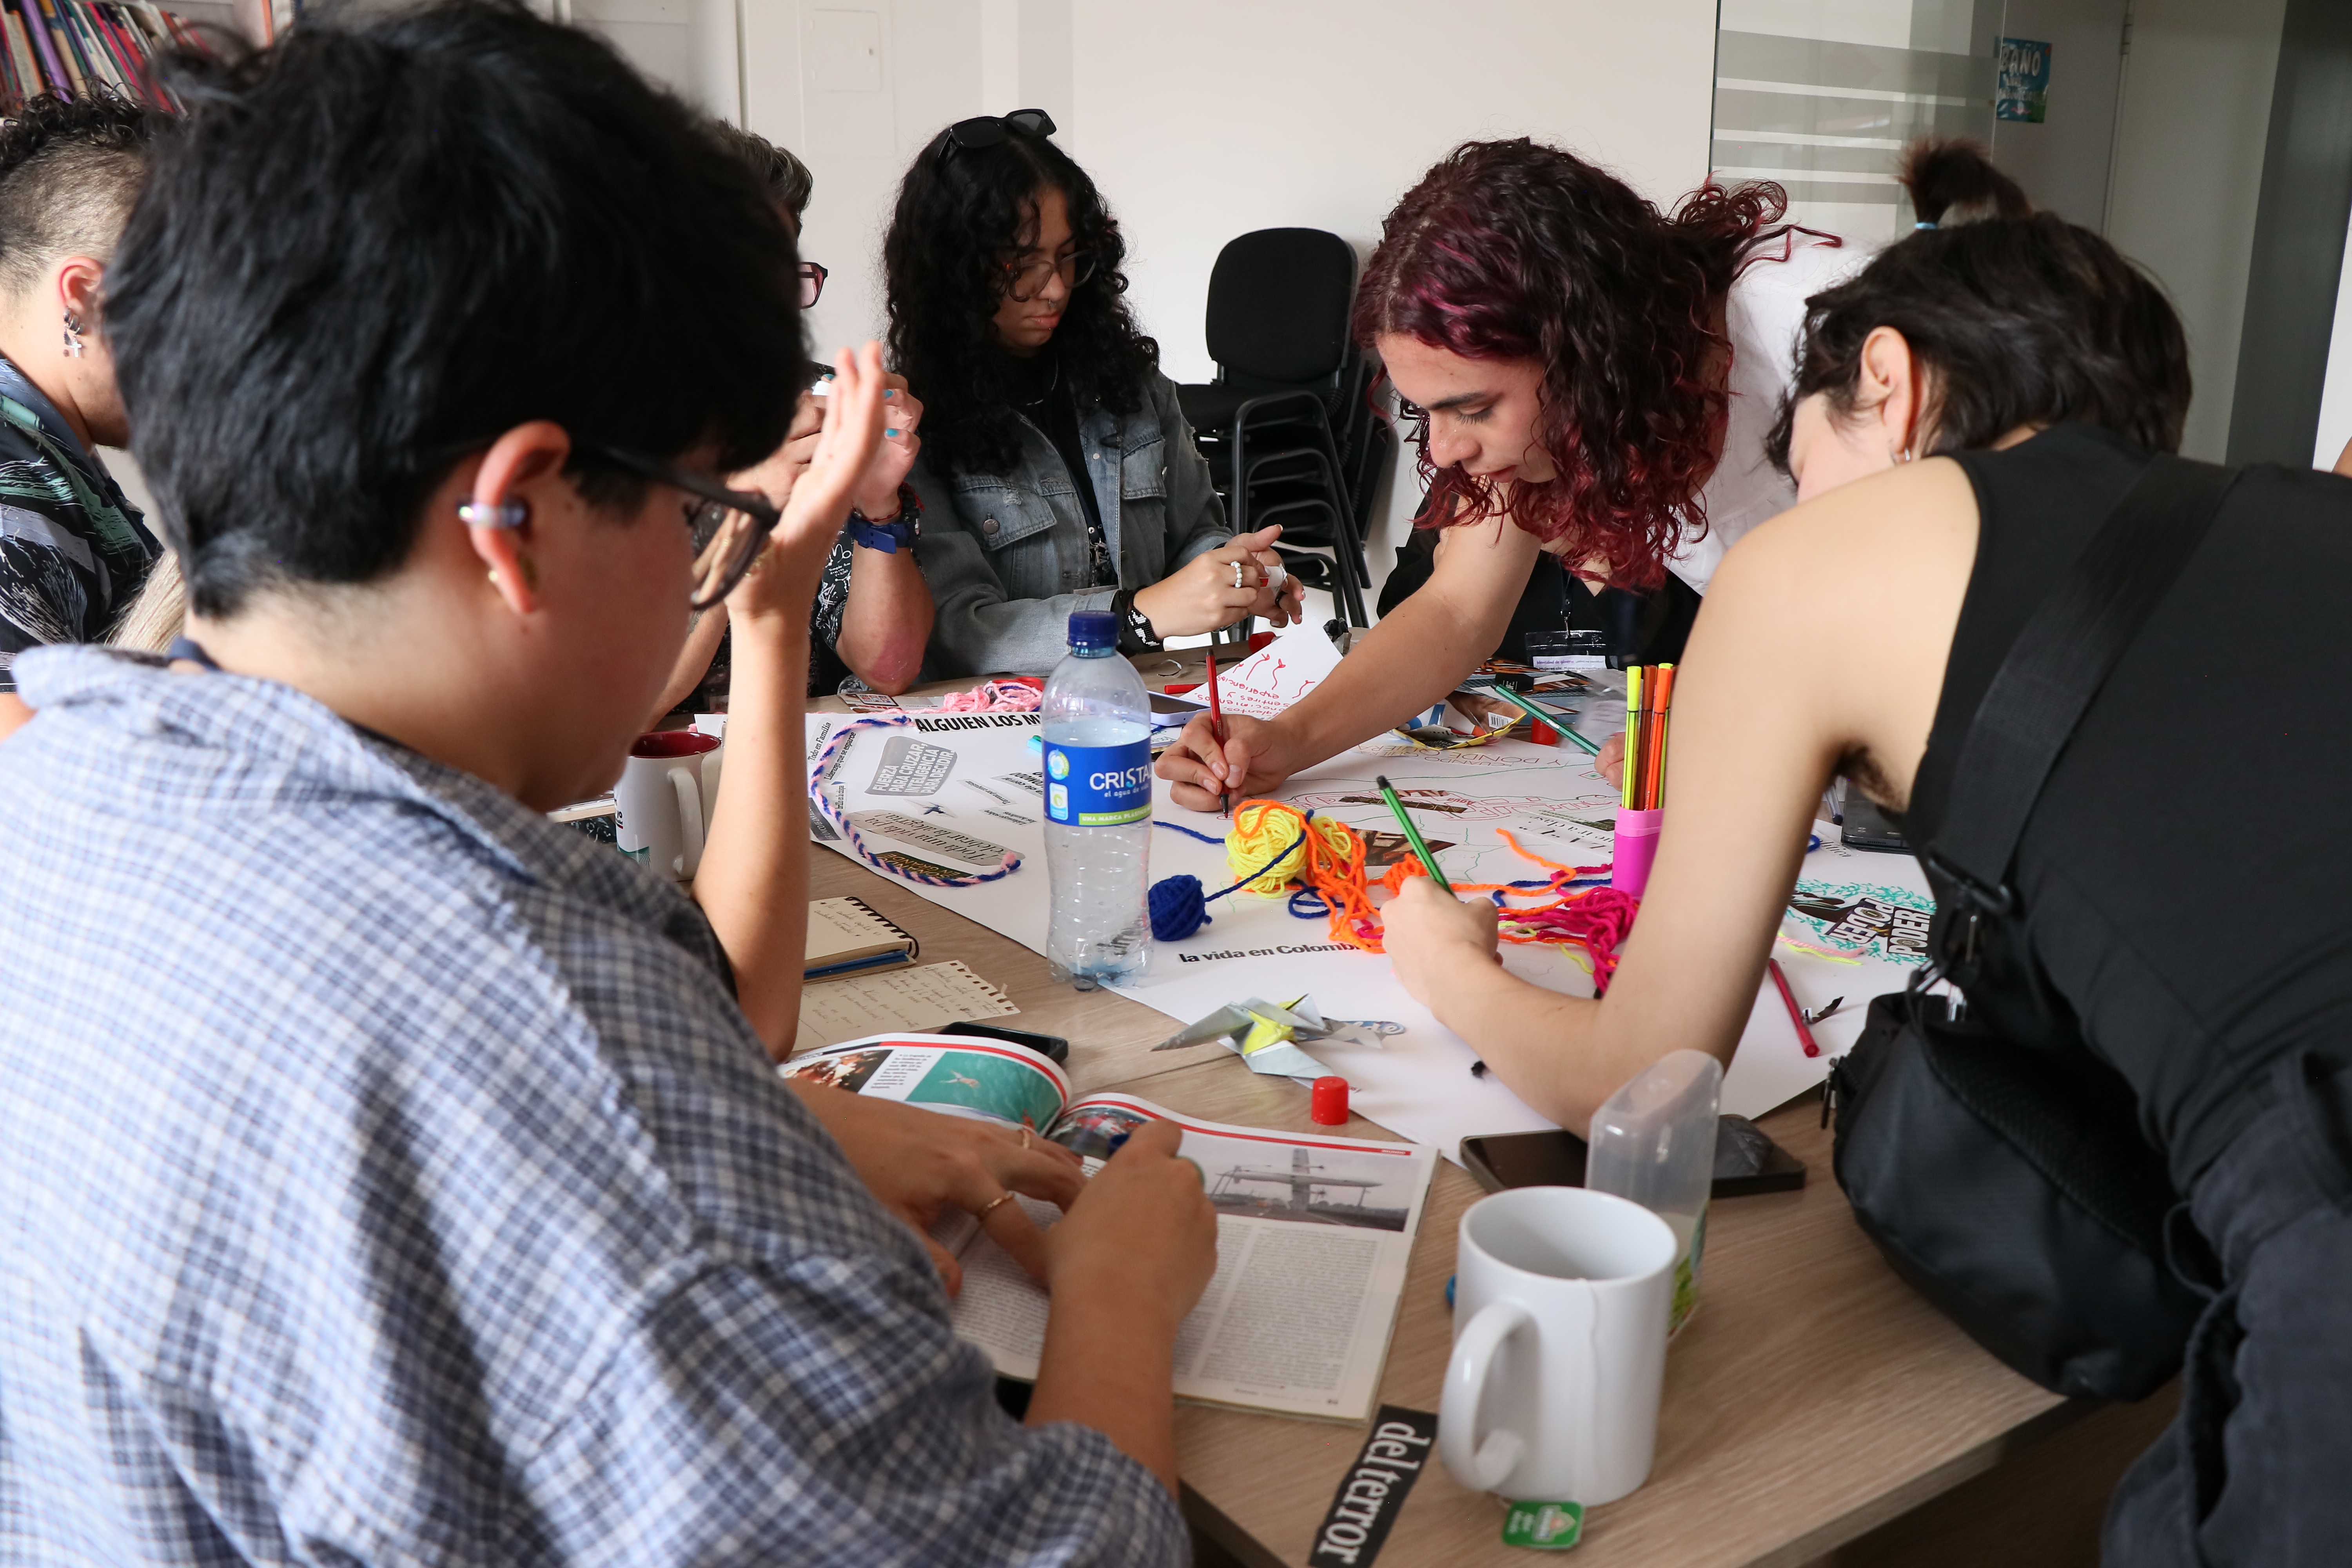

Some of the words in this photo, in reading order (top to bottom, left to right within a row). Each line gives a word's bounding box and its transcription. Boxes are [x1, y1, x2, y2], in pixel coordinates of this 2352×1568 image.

[1194, 693, 1285, 711] onocimienos,
[1240, 695, 1290, 707] sentires
[915, 716, 991, 732] ALGUIEN
[988, 715, 1023, 727] LOS
[816, 722, 831, 743] Familia
[808, 750, 819, 761] Todo
[816, 743, 822, 751] en
[1358, 744, 1440, 756] QUIERA
[824, 760, 841, 780] Liderazgo
[844, 732, 856, 751] esparce
[898, 743, 929, 775] CRUZAR,
[929, 750, 956, 778] DECIDIR.
[1449, 752, 1540, 764] DONDE
[872, 765, 899, 791] FUERZA
[904, 749, 940, 793] INTELIGENCIA
[1089, 764, 1151, 790] CRISTA
[888, 776, 911, 792] PARA
[920, 778, 942, 793] PARA
[1001, 777, 1025, 786] cerrar
[993, 793, 1011, 804] Terreno
[1114, 788, 1131, 799] agua
[1446, 797, 1476, 806] Agua
[884, 823, 913, 837] vida
[936, 828, 948, 838] la
[915, 834, 947, 847] una
[1820, 840, 1851, 857] lítica
[884, 854, 939, 871] GRANDE
[1889, 909, 1930, 957] PODER
[1179, 953, 1201, 963] la
[1201, 947, 1246, 961] vida
[1249, 947, 1275, 958] en
[1276, 942, 1362, 955] Colombi
[1363, 1421, 1432, 1471] del
[1317, 1467, 1403, 1565] terror
